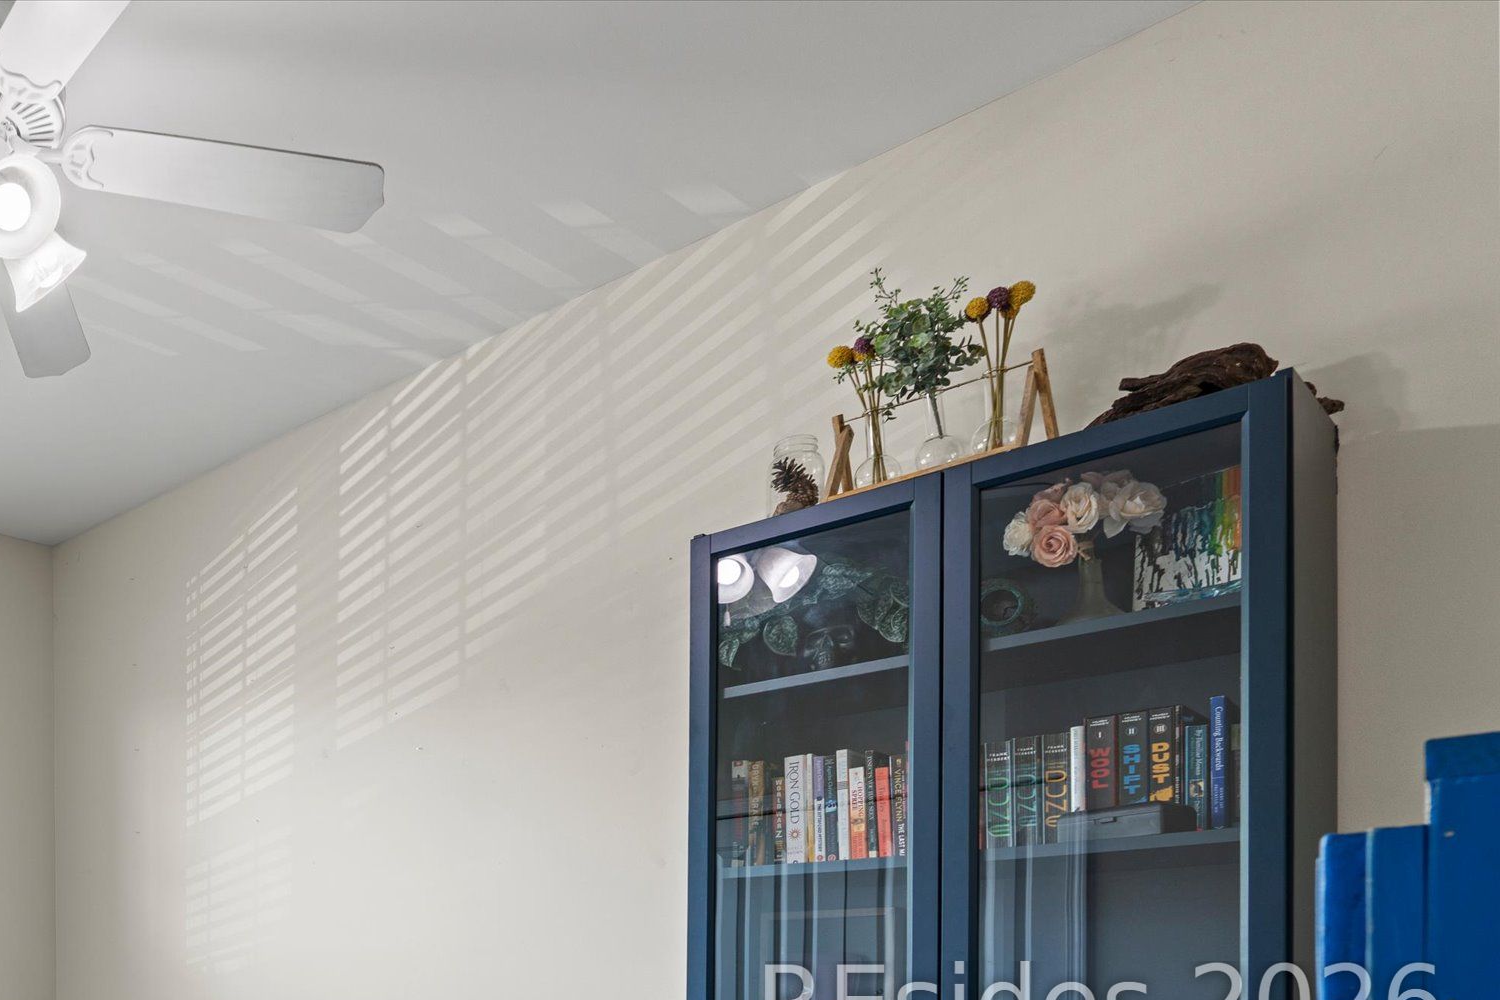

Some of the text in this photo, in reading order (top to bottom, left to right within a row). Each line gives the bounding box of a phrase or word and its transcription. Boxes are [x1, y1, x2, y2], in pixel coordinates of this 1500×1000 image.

[1151, 742, 1170, 784] DUST
[1213, 706, 1224, 771] Counting Backwards
[787, 761, 800, 824] IRON GOLD
[1090, 747, 1110, 789] WOOL
[1123, 744, 1140, 794] SHIFT
[894, 769, 903, 822] VINCE FLYNN
[776, 830, 782, 838] Z
